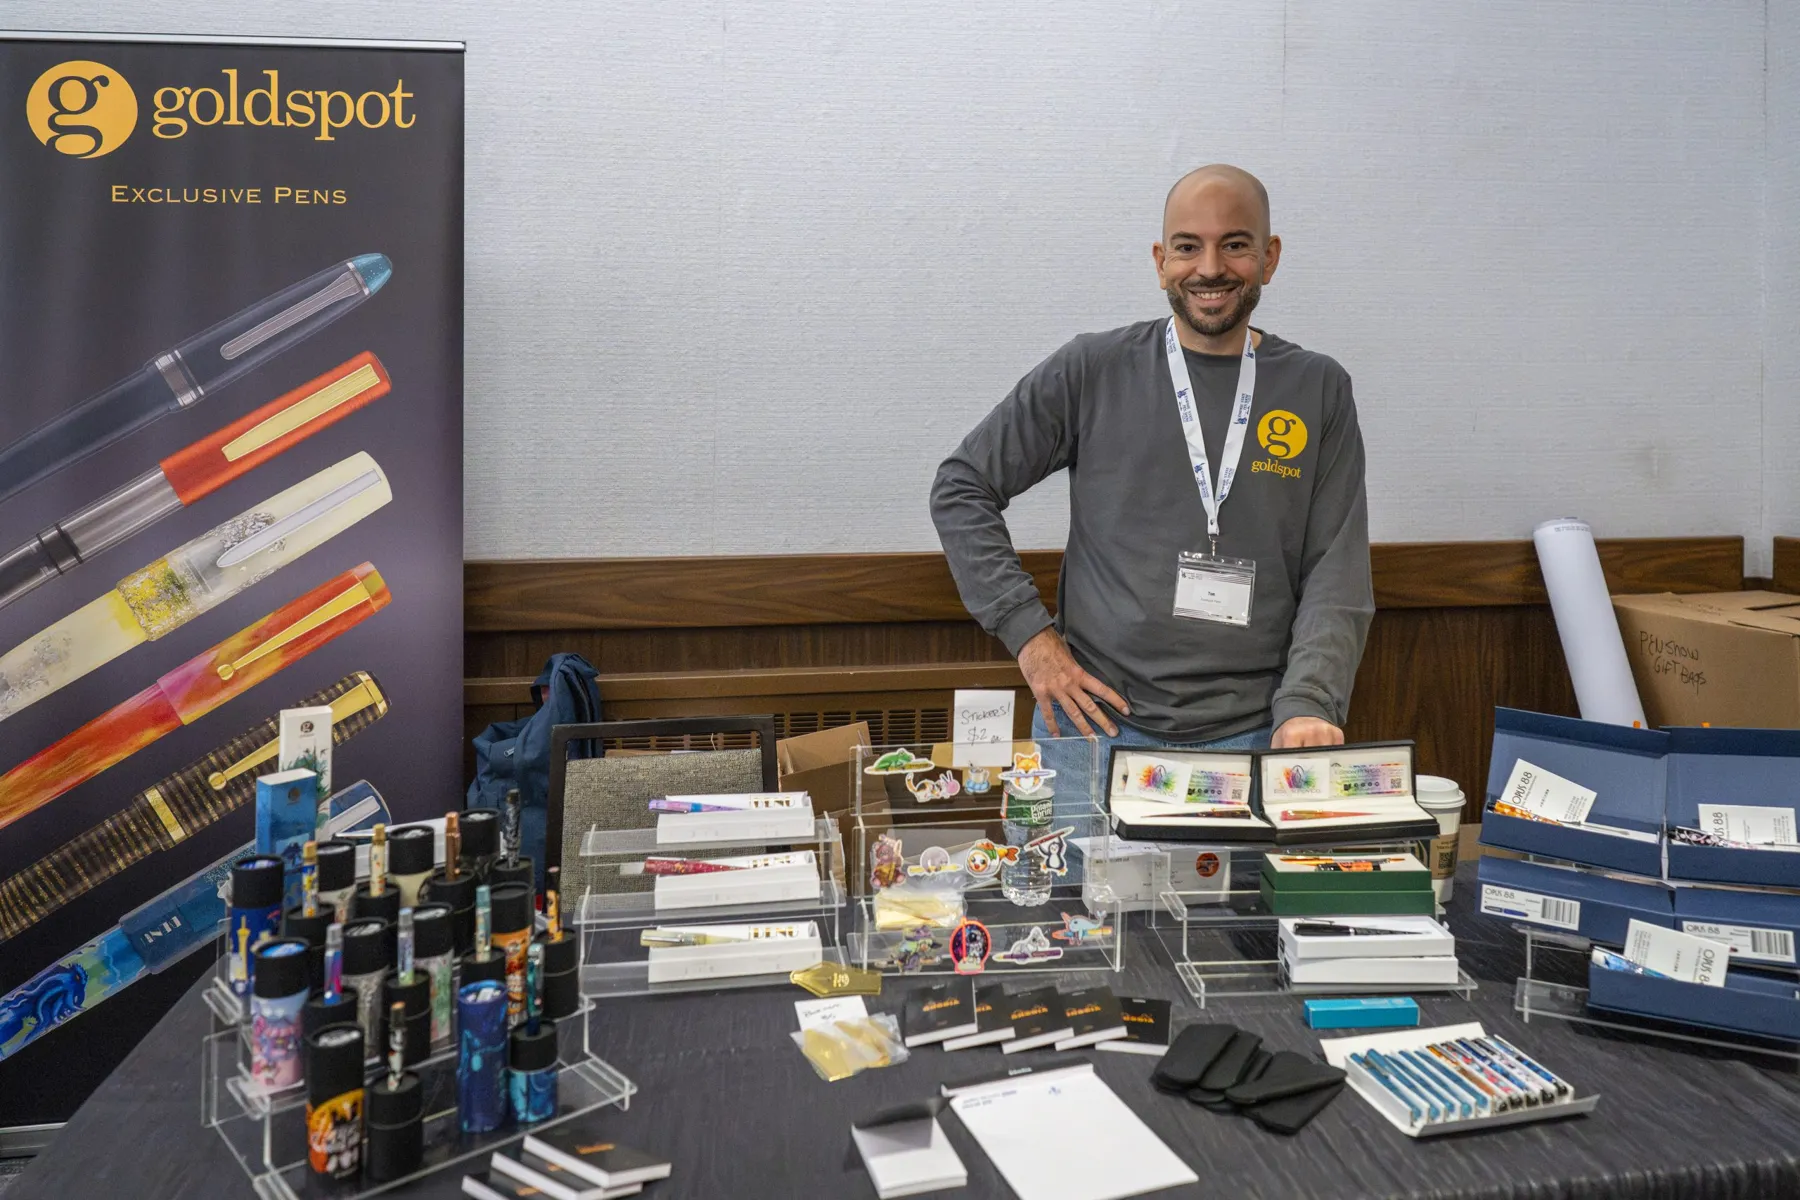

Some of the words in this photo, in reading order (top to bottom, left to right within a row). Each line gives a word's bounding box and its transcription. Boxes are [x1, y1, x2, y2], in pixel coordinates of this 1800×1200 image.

[153, 69, 416, 140] goldspot
[1251, 459, 1302, 478] goldspot
[967, 726, 987, 746] $2
[1512, 784, 1526, 805] OPUS
[1520, 771, 1533, 785] 88
[1713, 811, 1724, 825] 88
[1484, 887, 1503, 898] OPUS
[1503, 891, 1515, 899] 88
[1686, 924, 1705, 935] OPUS
[1708, 926, 1721, 936] 88
[1701, 949, 1716, 977] OPUS
[1699, 975, 1711, 985] 8
